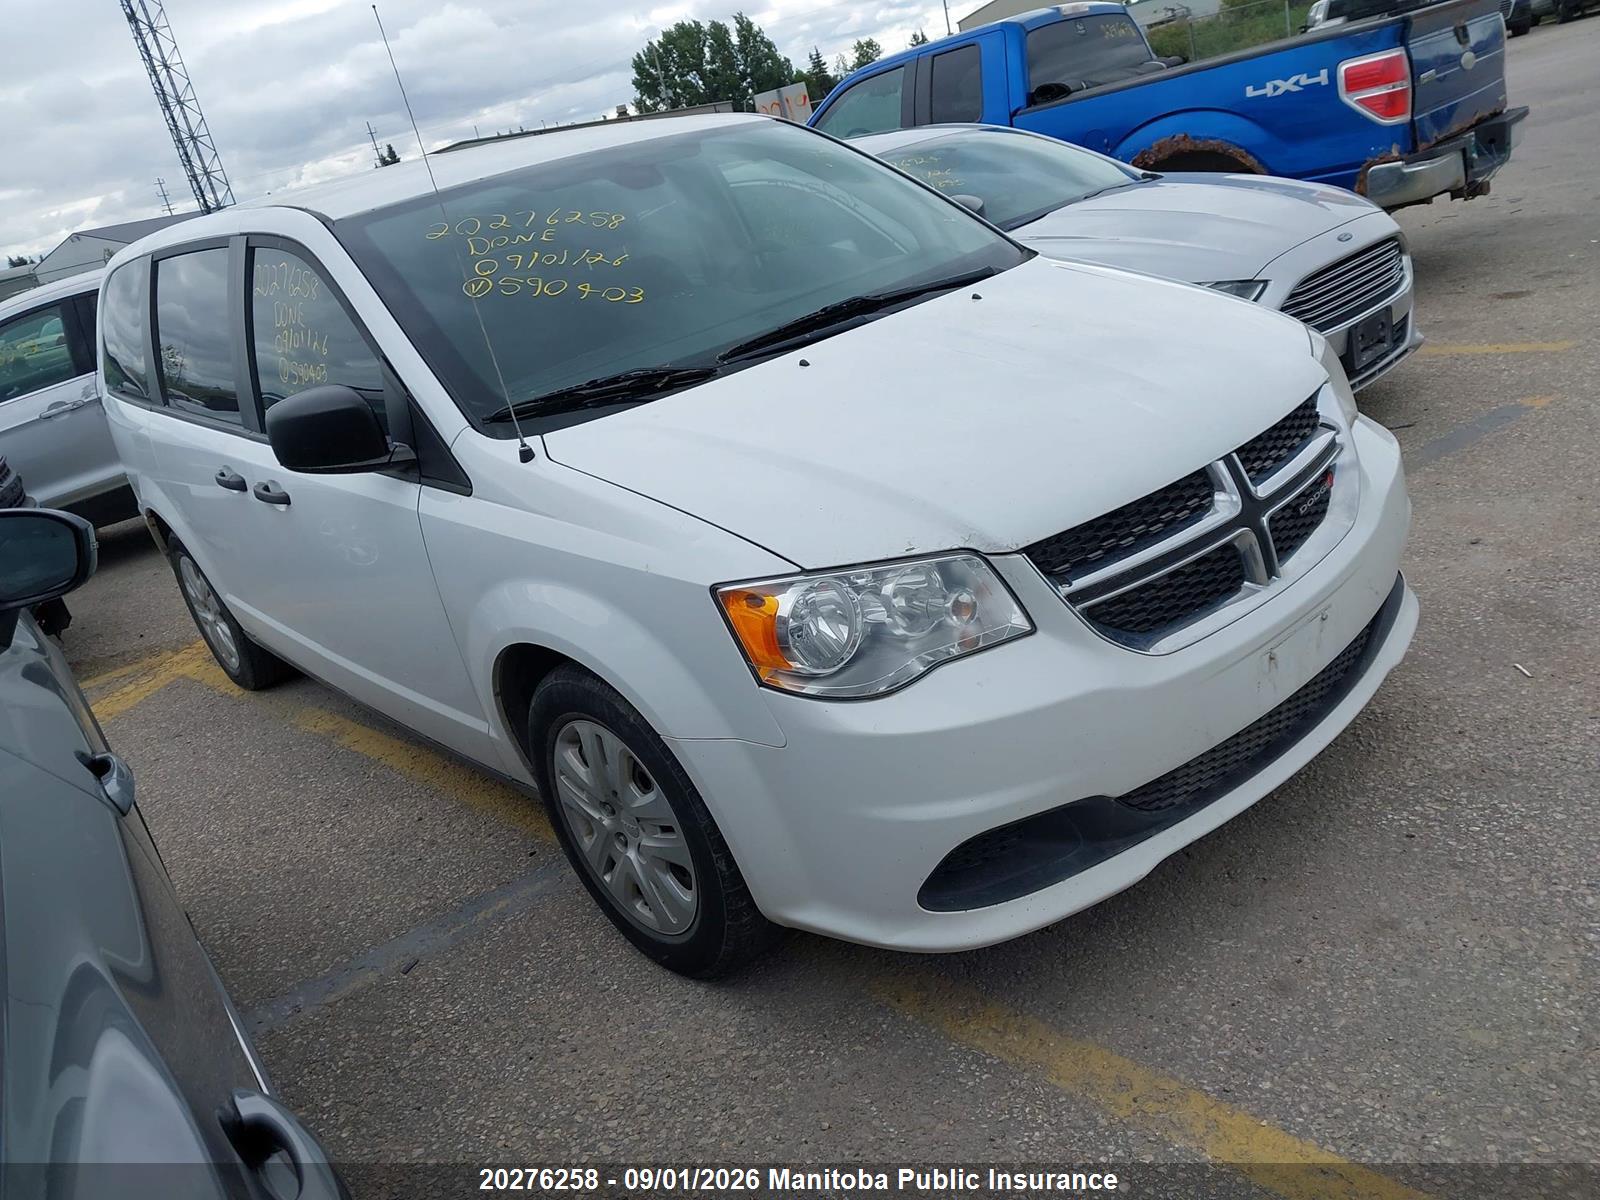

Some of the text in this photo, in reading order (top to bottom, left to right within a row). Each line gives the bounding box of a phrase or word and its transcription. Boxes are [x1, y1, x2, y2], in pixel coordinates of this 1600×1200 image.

[425, 207, 626, 240] 20276258
[467, 229, 557, 256] DONE
[274, 301, 306, 328] DONE
